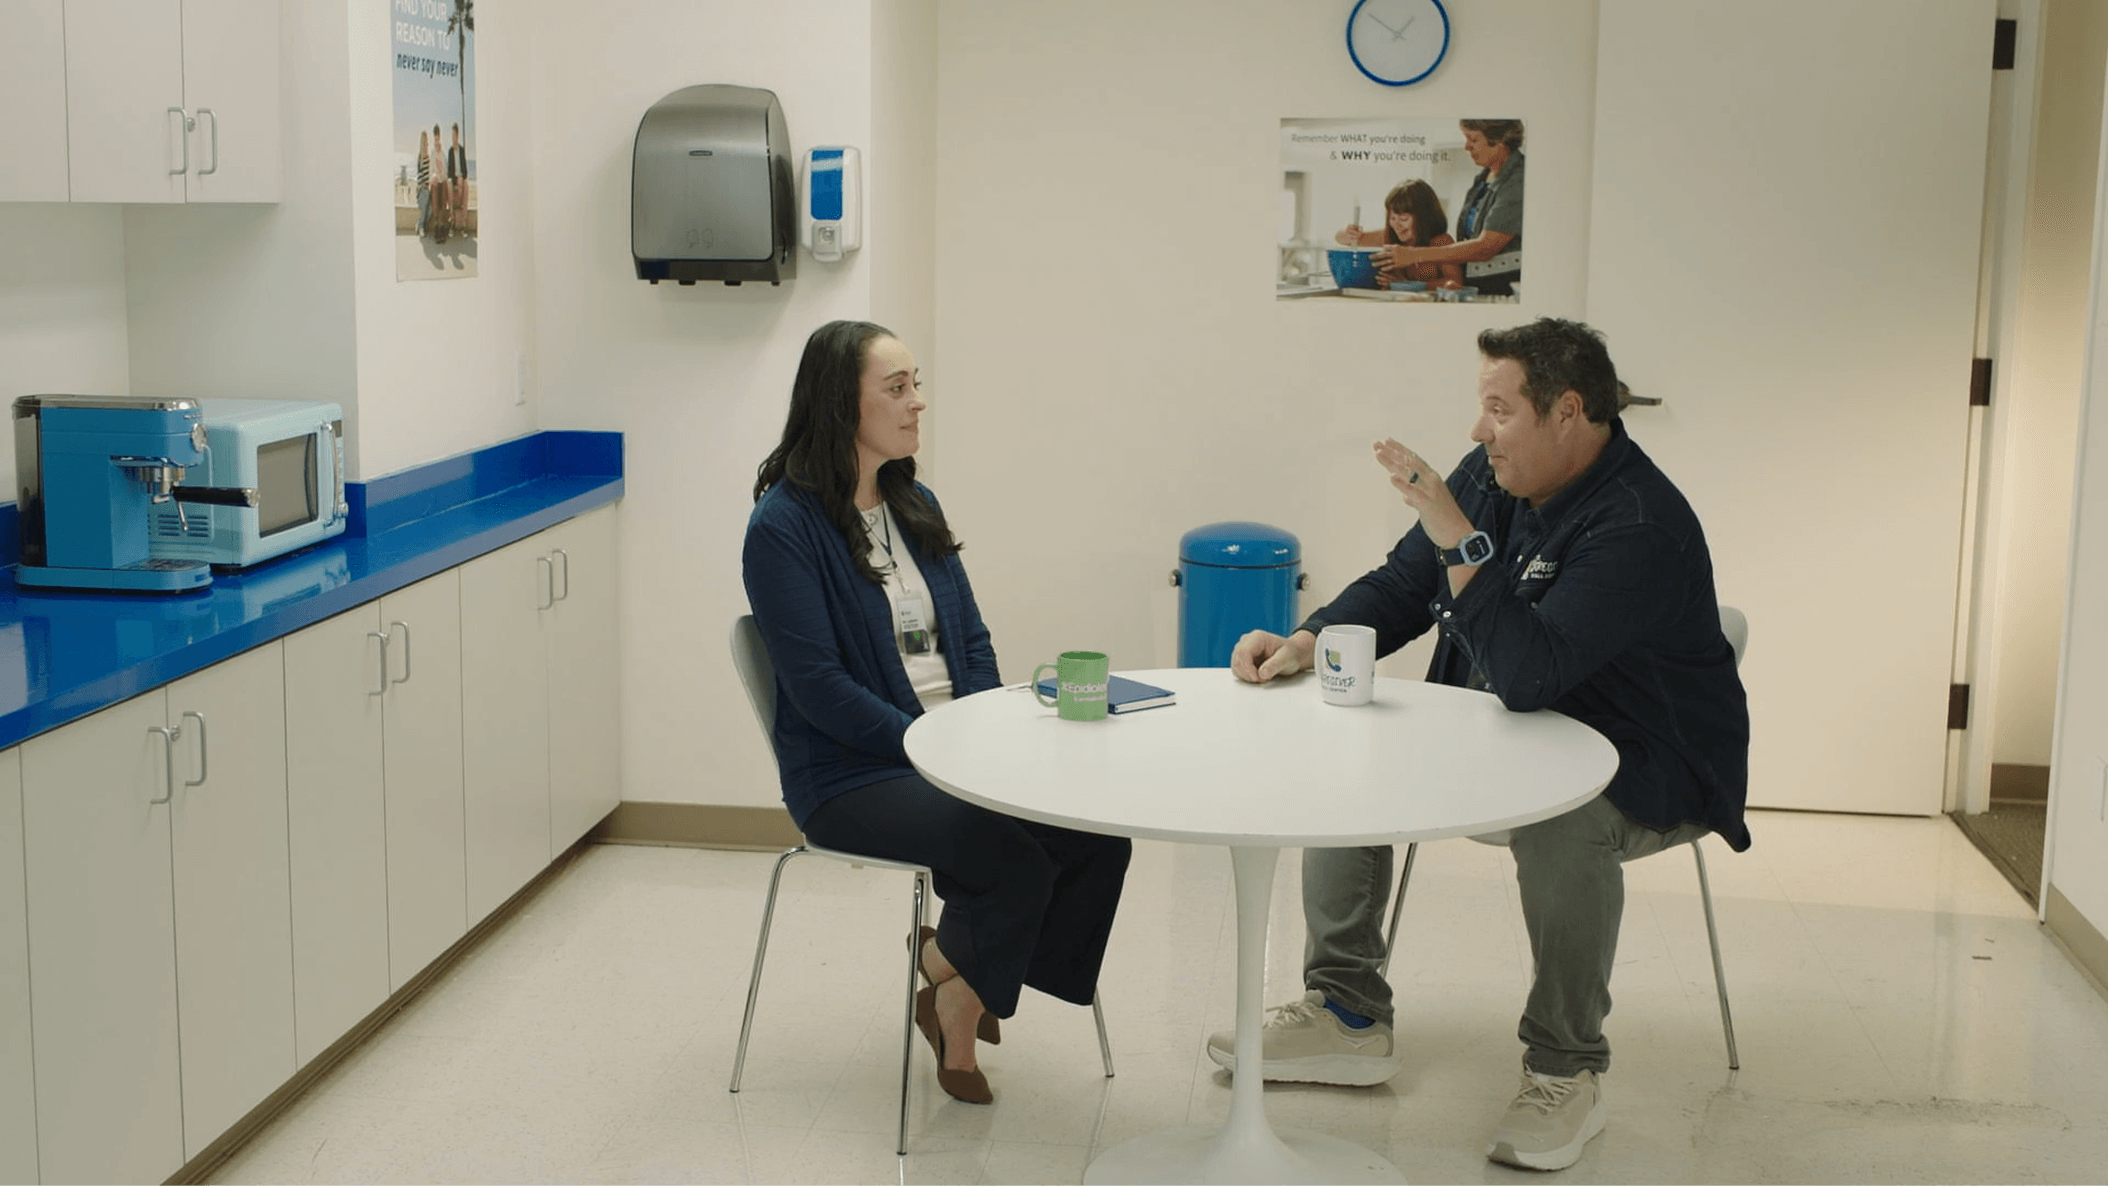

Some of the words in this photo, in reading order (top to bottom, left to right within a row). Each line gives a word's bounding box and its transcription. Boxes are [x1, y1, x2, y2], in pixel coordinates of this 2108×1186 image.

[421, 0, 447, 21] YOUR
[396, 21, 435, 47] REASON
[437, 30, 450, 50] TO
[396, 54, 420, 71] never
[421, 58, 435, 79] say
[436, 61, 458, 77] never
[1291, 133, 1338, 142] Remember
[1340, 133, 1367, 142] WHAT
[1369, 135, 1398, 145] you're
[1400, 133, 1426, 146] doing
[1329, 150, 1337, 160] &
[1342, 151, 1371, 160] WHY
[1373, 150, 1407, 163] you're
[1409, 150, 1439, 164] doing
[1441, 150, 1451, 161] it.
